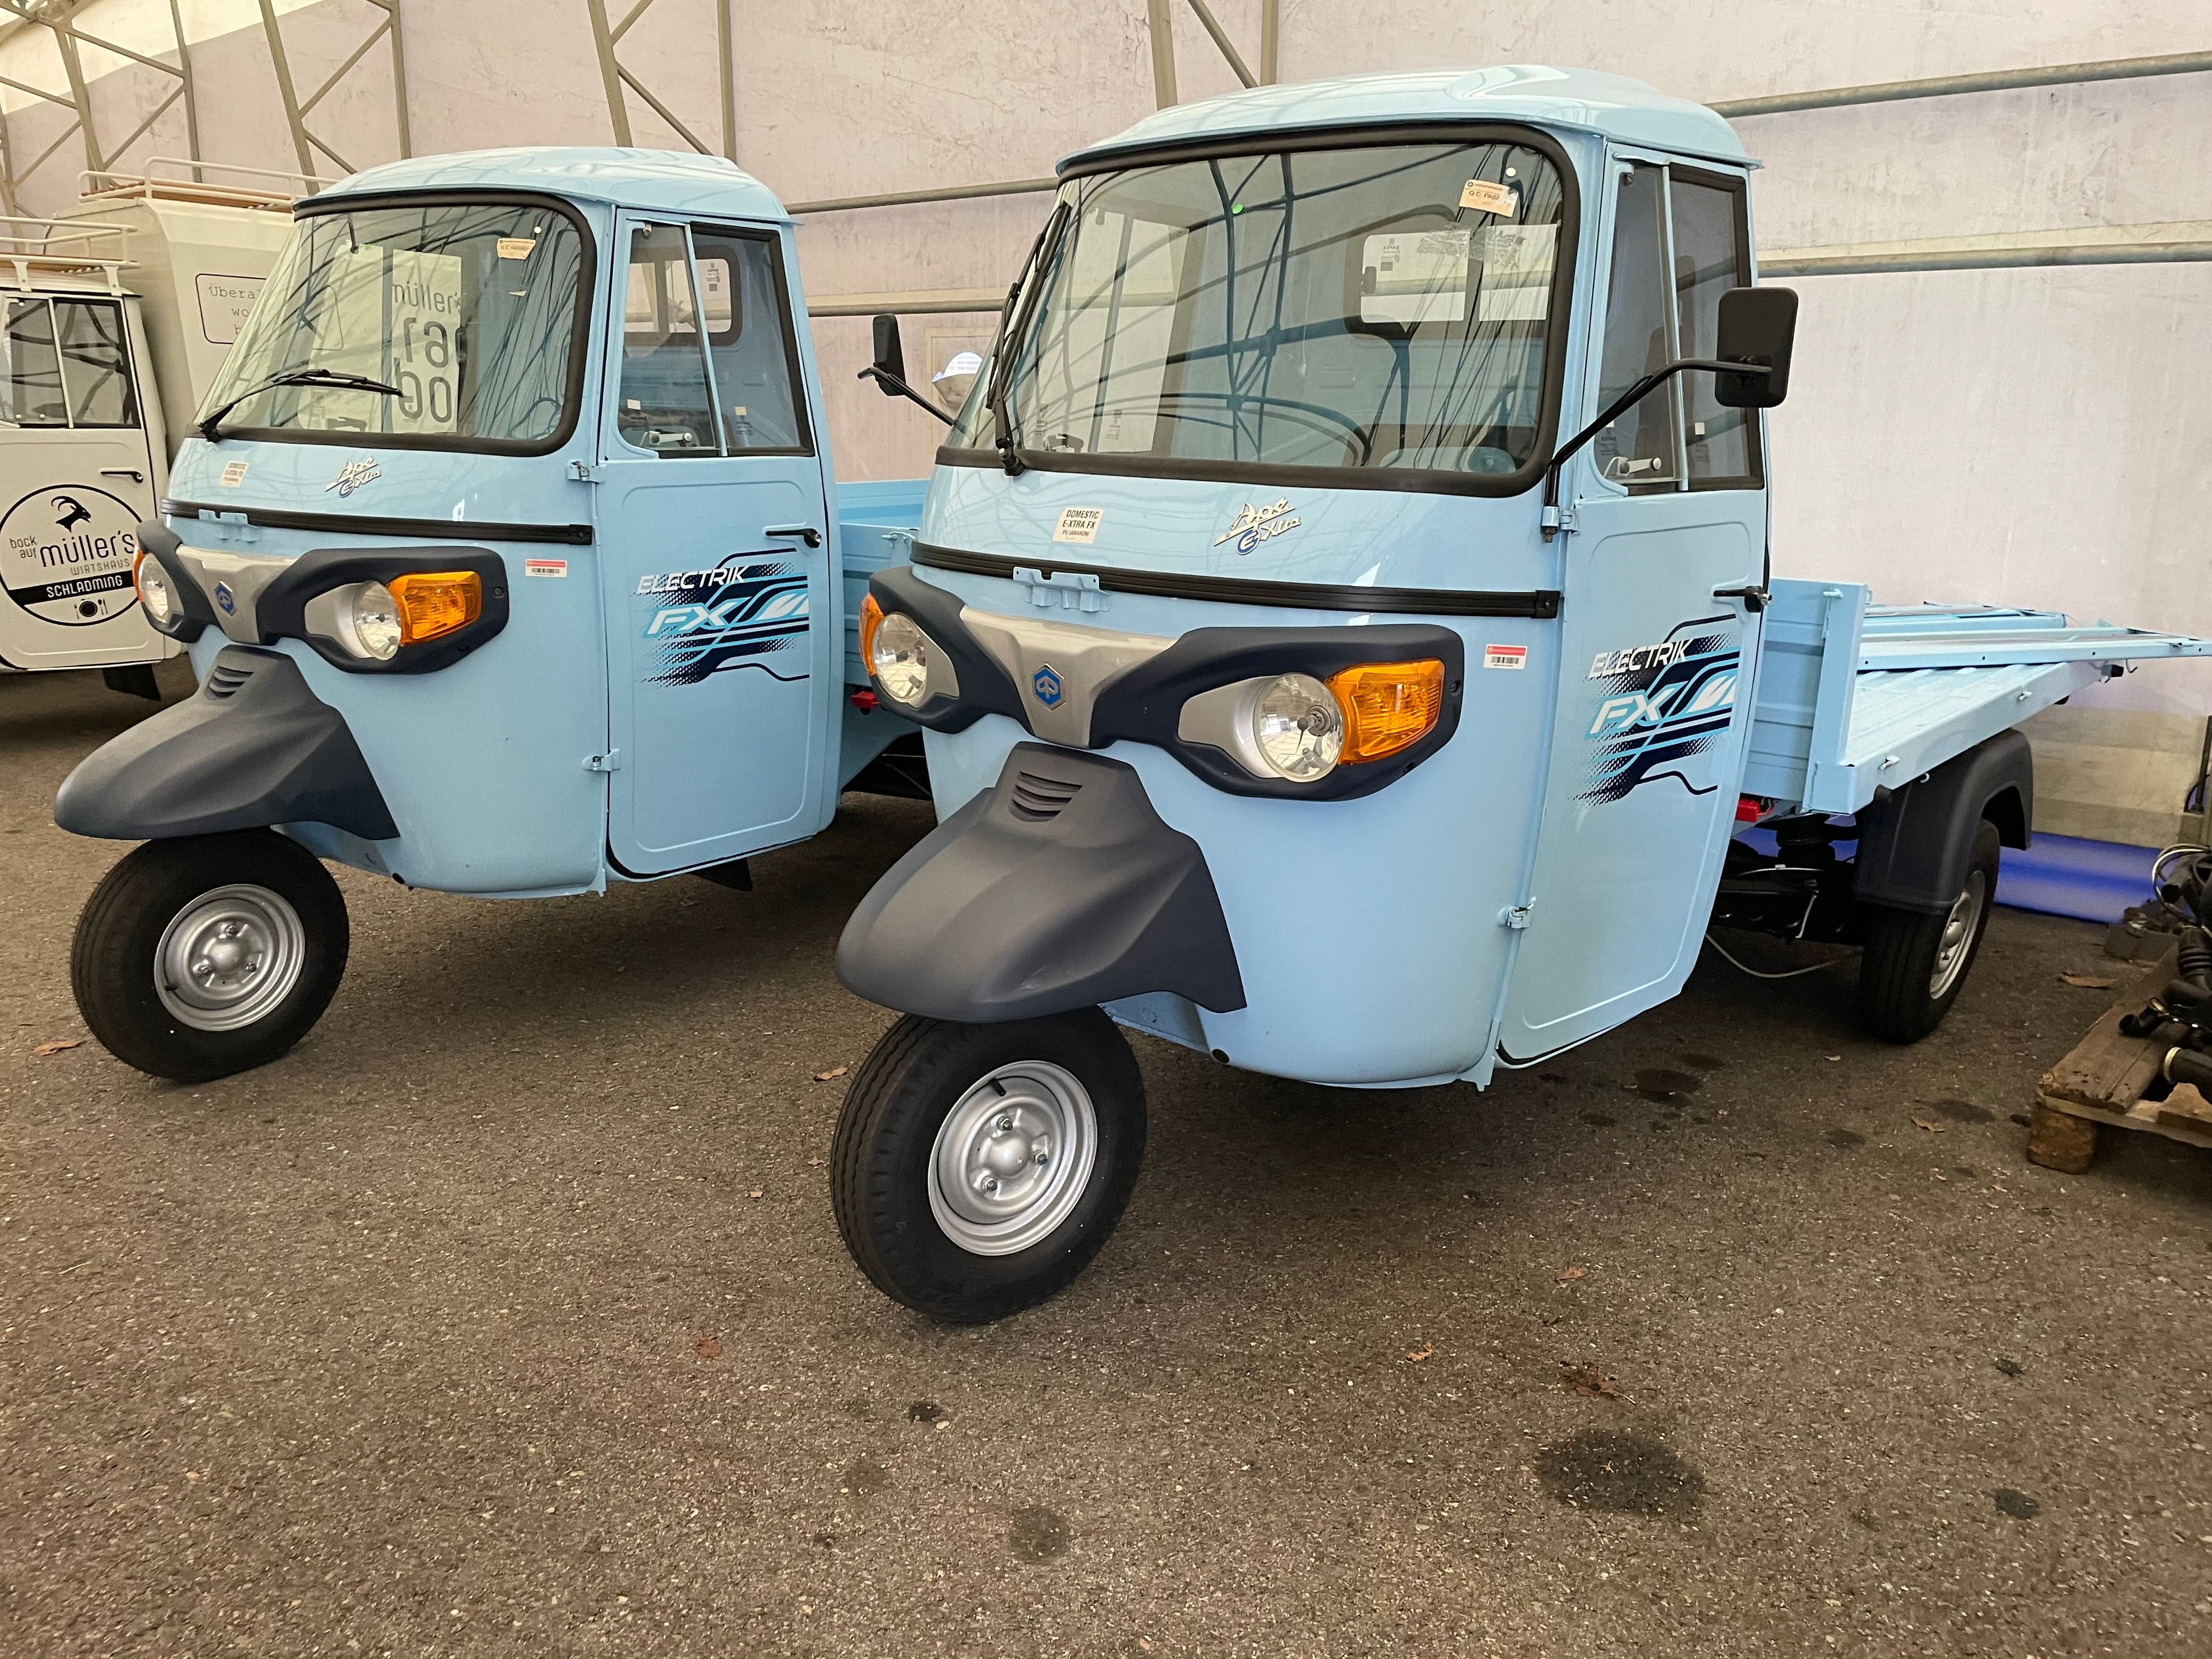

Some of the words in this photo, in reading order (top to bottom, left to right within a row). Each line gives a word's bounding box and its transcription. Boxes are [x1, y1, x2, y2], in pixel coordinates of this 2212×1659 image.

[1062, 520, 1085, 528] E-XTRA
[1086, 521, 1096, 529] FX
[1066, 510, 1099, 519] DOMESTIC
[1222, 497, 1294, 535] Ape
[9, 535, 37, 548] bock
[20, 547, 37, 559] auf
[40, 530, 135, 567] müller's
[70, 558, 130, 576] WIRTSHAUS
[637, 565, 749, 594] ELECTRIK
[46, 575, 123, 598] SCHLADMING
[646, 600, 740, 635] FX
[1588, 639, 1694, 679] ELECTRIK
[1588, 686, 1678, 735] FX
